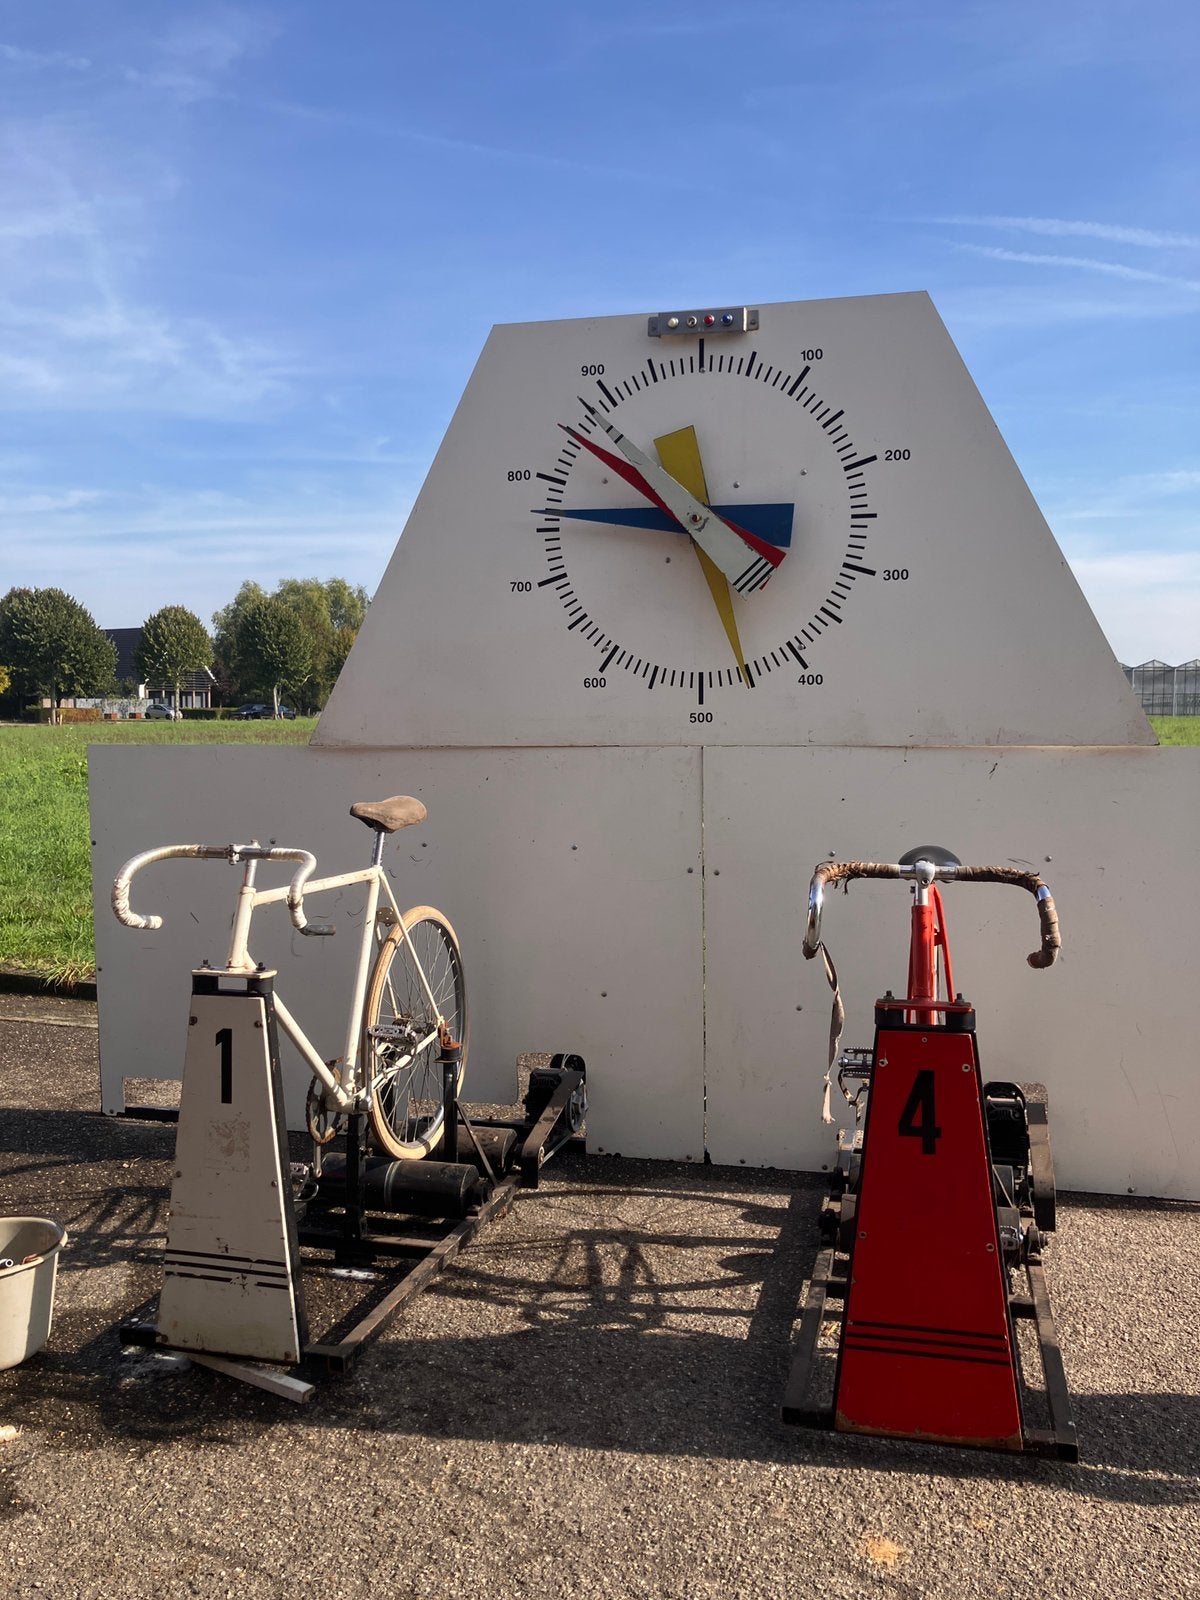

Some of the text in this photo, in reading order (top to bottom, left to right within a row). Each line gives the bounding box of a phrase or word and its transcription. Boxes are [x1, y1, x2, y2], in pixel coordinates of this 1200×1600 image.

[800, 348, 824, 362] 100
[580, 363, 605, 377] 900
[884, 448, 911, 462] 200
[507, 469, 531, 482] 800
[882, 568, 909, 581] 300
[509, 581, 532, 593] 700
[583, 676, 607, 689] 600
[797, 673, 824, 686] 400
[689, 711, 714, 724] 500
[214, 1027, 233, 1105] 1
[898, 1070, 942, 1156] 4
